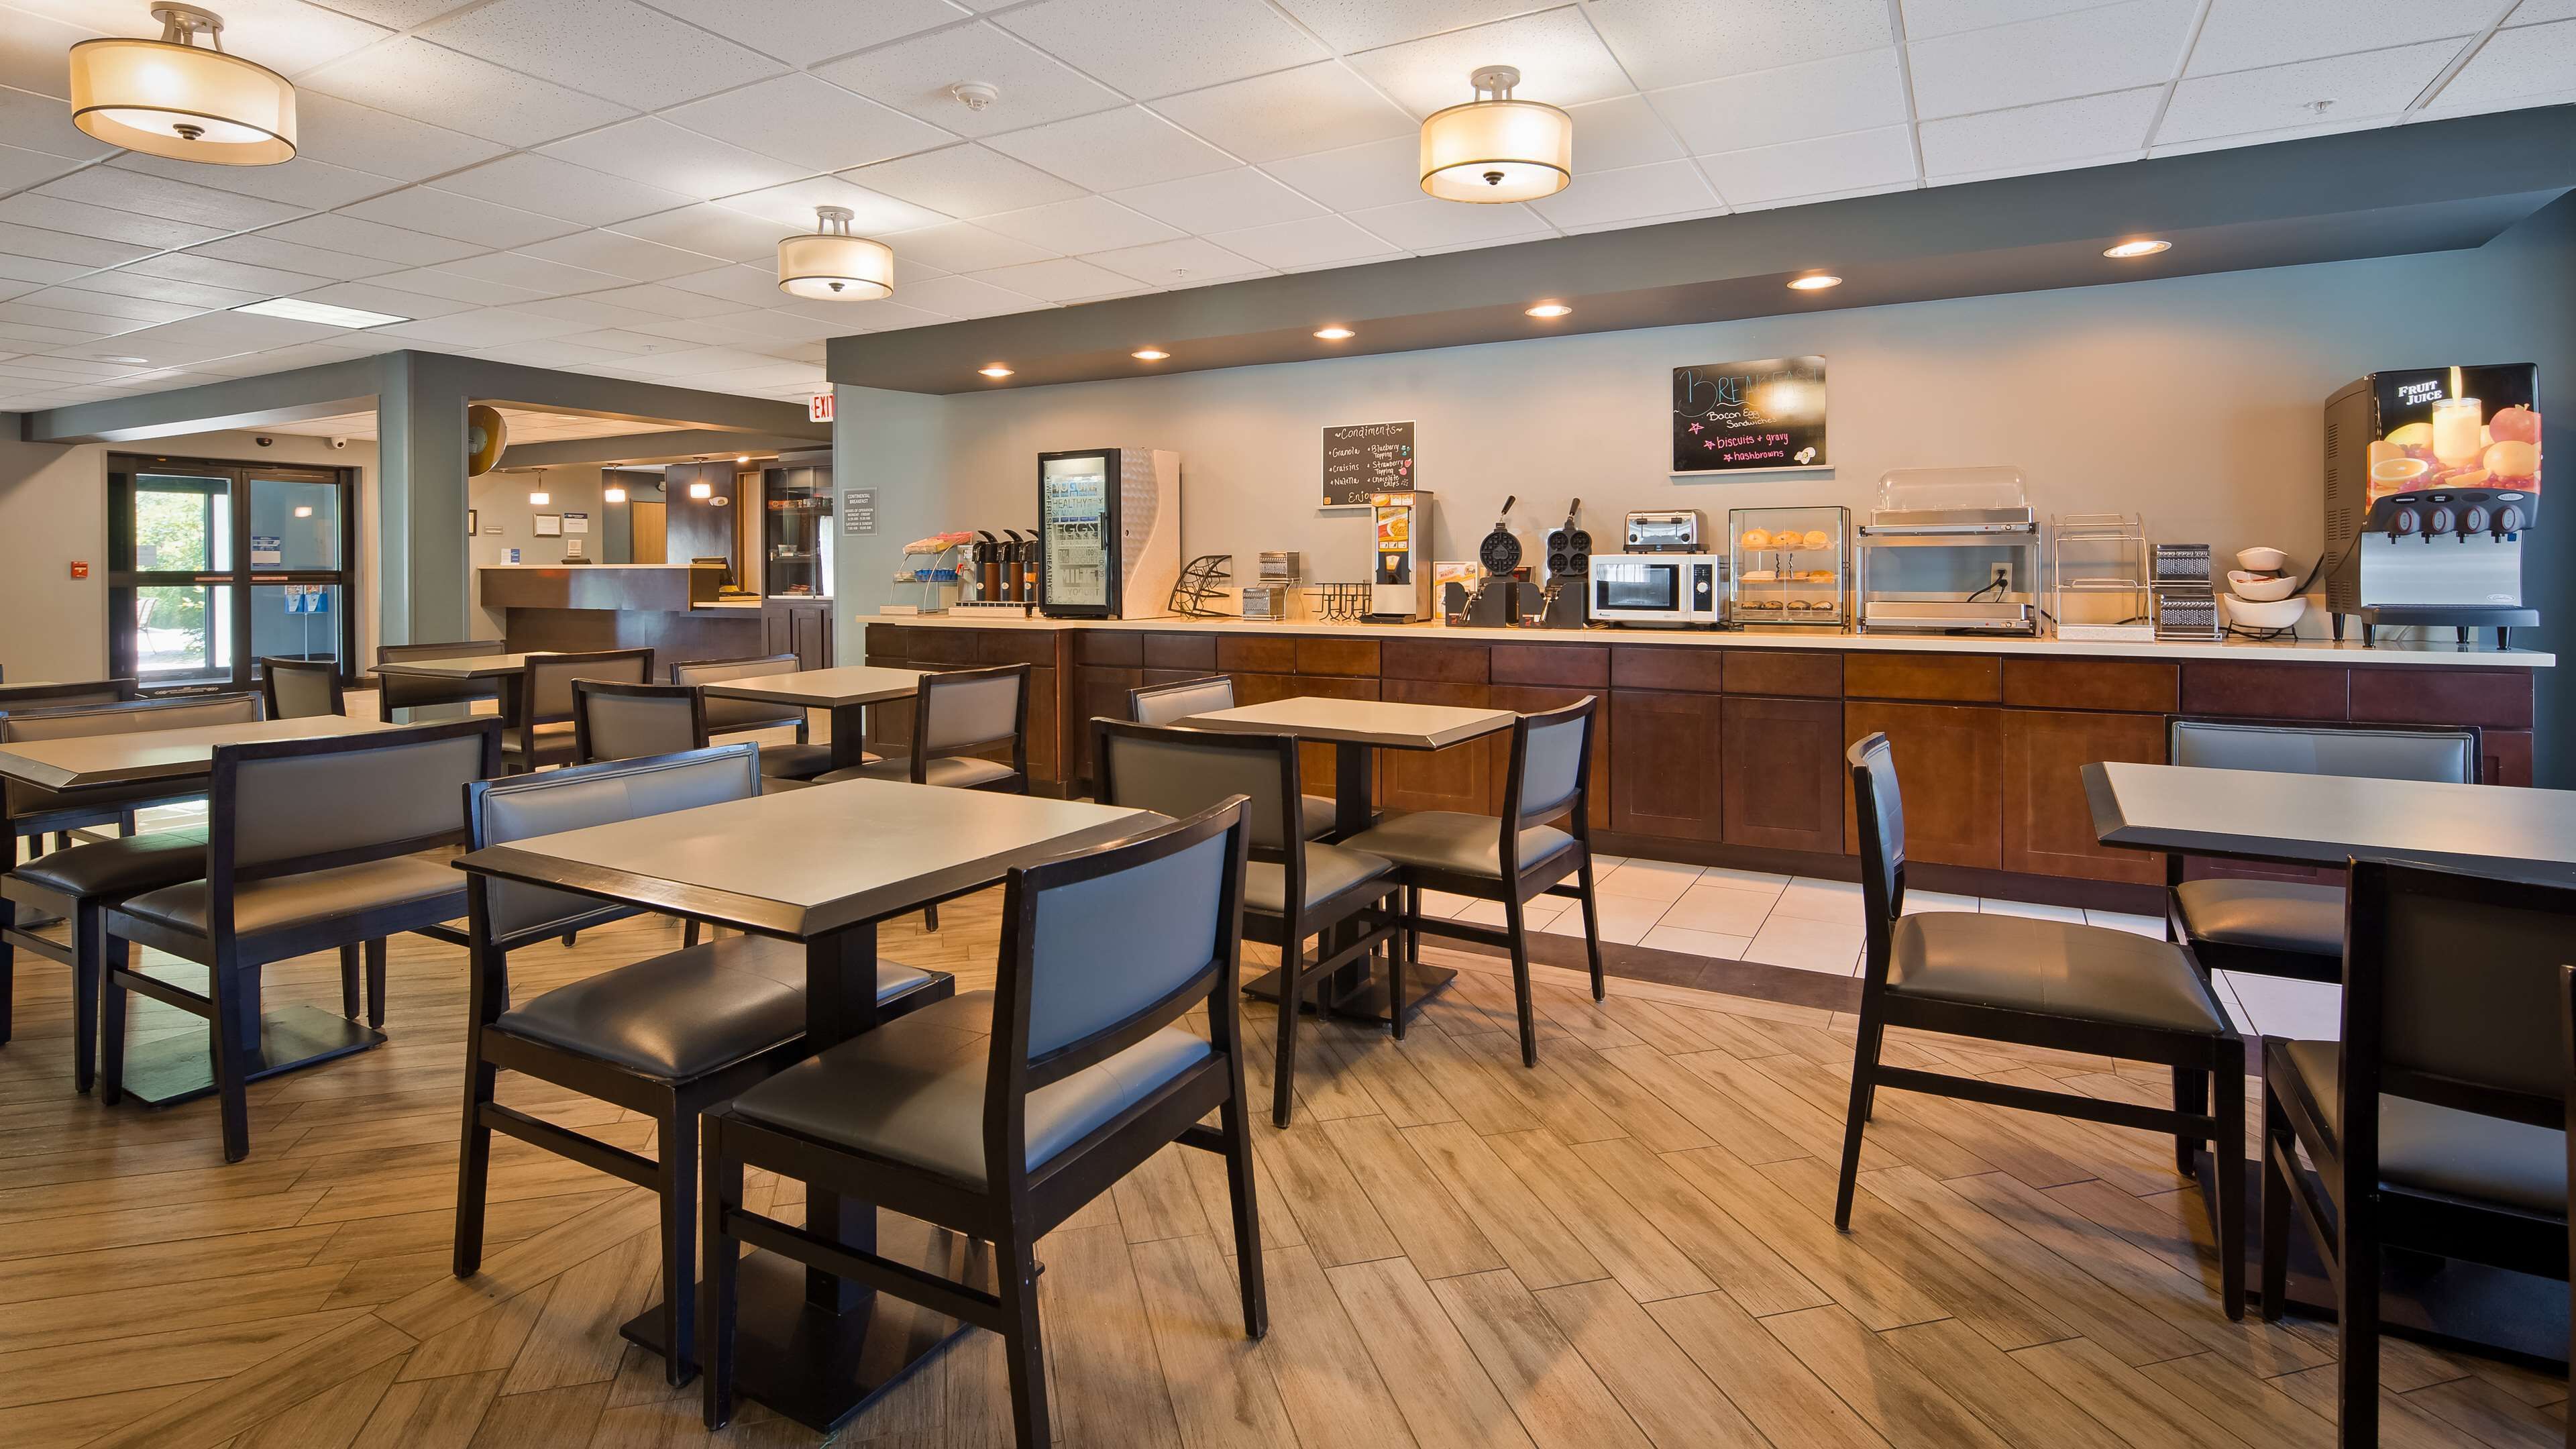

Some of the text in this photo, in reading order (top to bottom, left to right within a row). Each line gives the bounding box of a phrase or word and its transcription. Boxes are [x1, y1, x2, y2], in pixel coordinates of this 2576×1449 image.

[2398, 380, 2438, 397] FRUIT
[2406, 390, 2442, 405] JUICE
[814, 396, 834, 419] EXIT
[1707, 408, 1760, 421] Bacon Egg
[1726, 417, 1778, 429] Sandwiches
[1717, 435, 1755, 449] biscuits
[1766, 433, 1789, 445] gravy
[1332, 446, 1360, 458] Granola
[1371, 443, 1399, 453] Blueberry
[1373, 451, 1393, 461] Topping
[1733, 450, 1784, 462] hashbrowns
[1332, 462, 1360, 473] Craisins
[1373, 460, 1404, 469] Strawberry
[1372, 474, 1400, 482] Chocolate
[1374, 468, 1394, 476] Topping
[1334, 477, 1360, 486] Nutella
